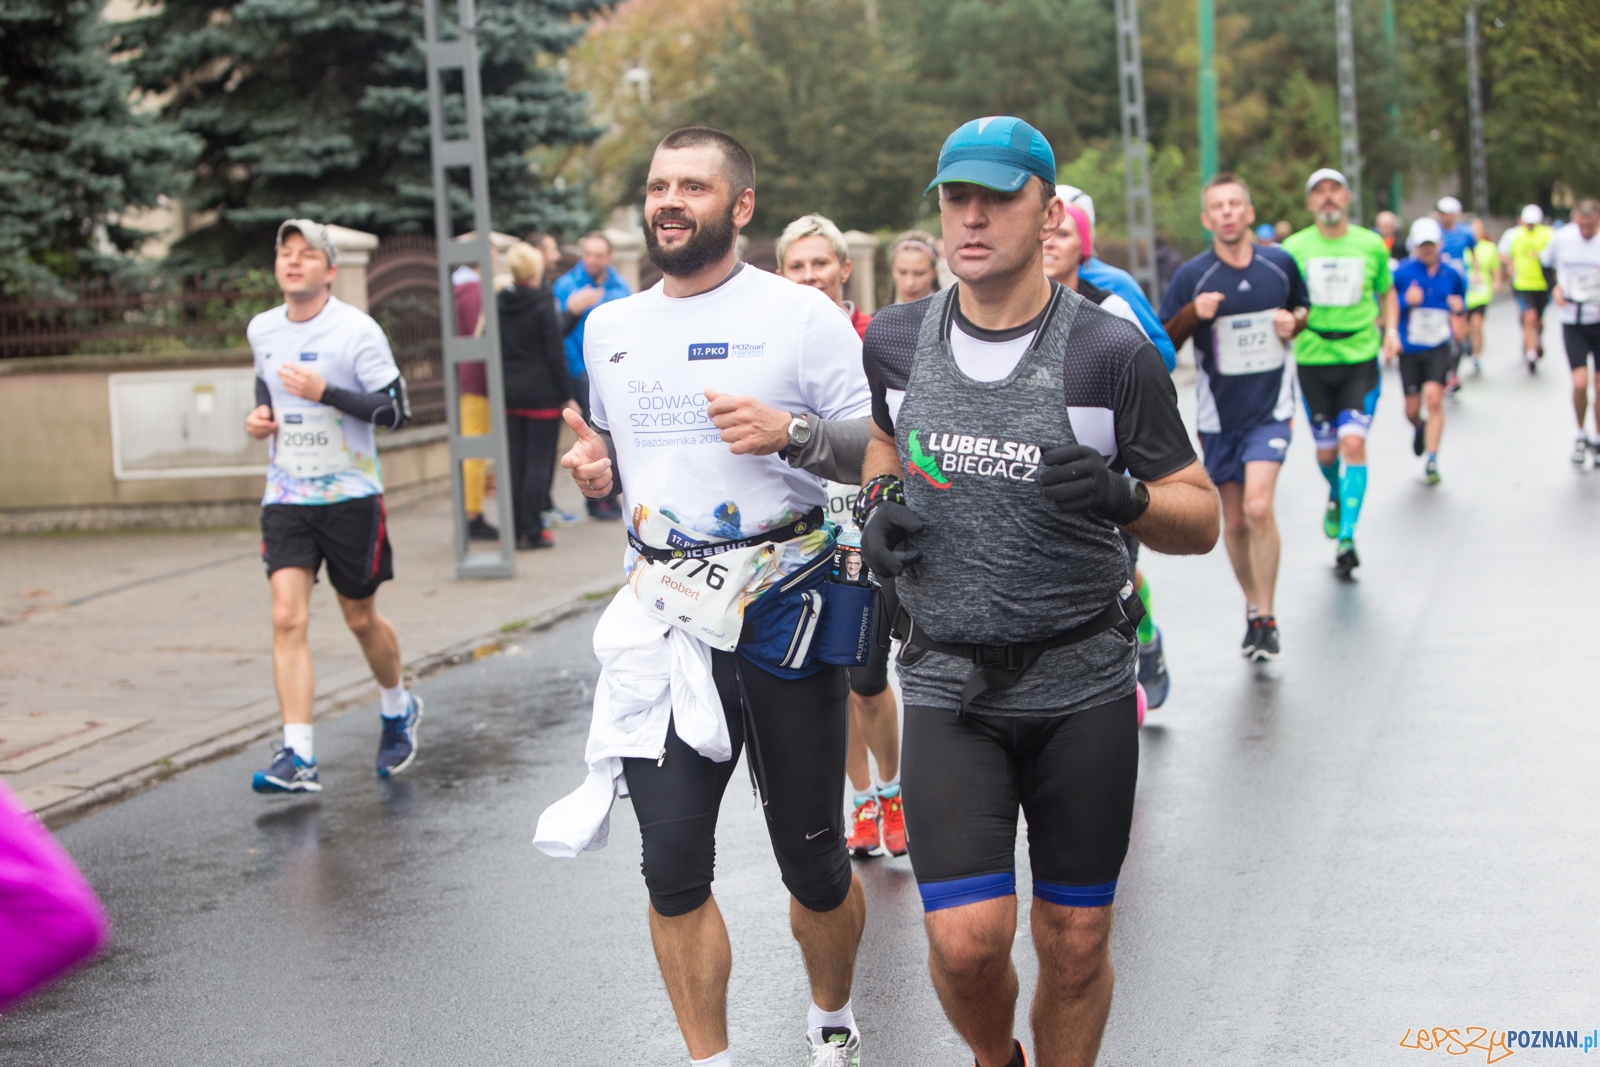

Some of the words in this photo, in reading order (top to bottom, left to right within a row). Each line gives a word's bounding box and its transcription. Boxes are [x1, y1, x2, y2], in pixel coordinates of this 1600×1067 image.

[609, 351, 628, 364] 4F
[691, 347, 704, 356] 17.
[705, 346, 726, 355] PKO
[627, 380, 664, 394] SIŁA
[638, 392, 711, 410] ODWAG
[629, 407, 714, 427] SZYBKOŚ
[284, 431, 329, 447] 2096
[634, 437, 641, 448] 9
[699, 433, 723, 445] 2016
[928, 432, 1042, 464] LUBELSKI
[942, 453, 1039, 482] BIEGACZ
[826, 494, 858, 514] 06
[671, 534, 683, 547] 17.
[686, 541, 748, 559] ICEBUG
[660, 574, 701, 600] Robert
[855, 604, 870, 663] MULTIPOWER
